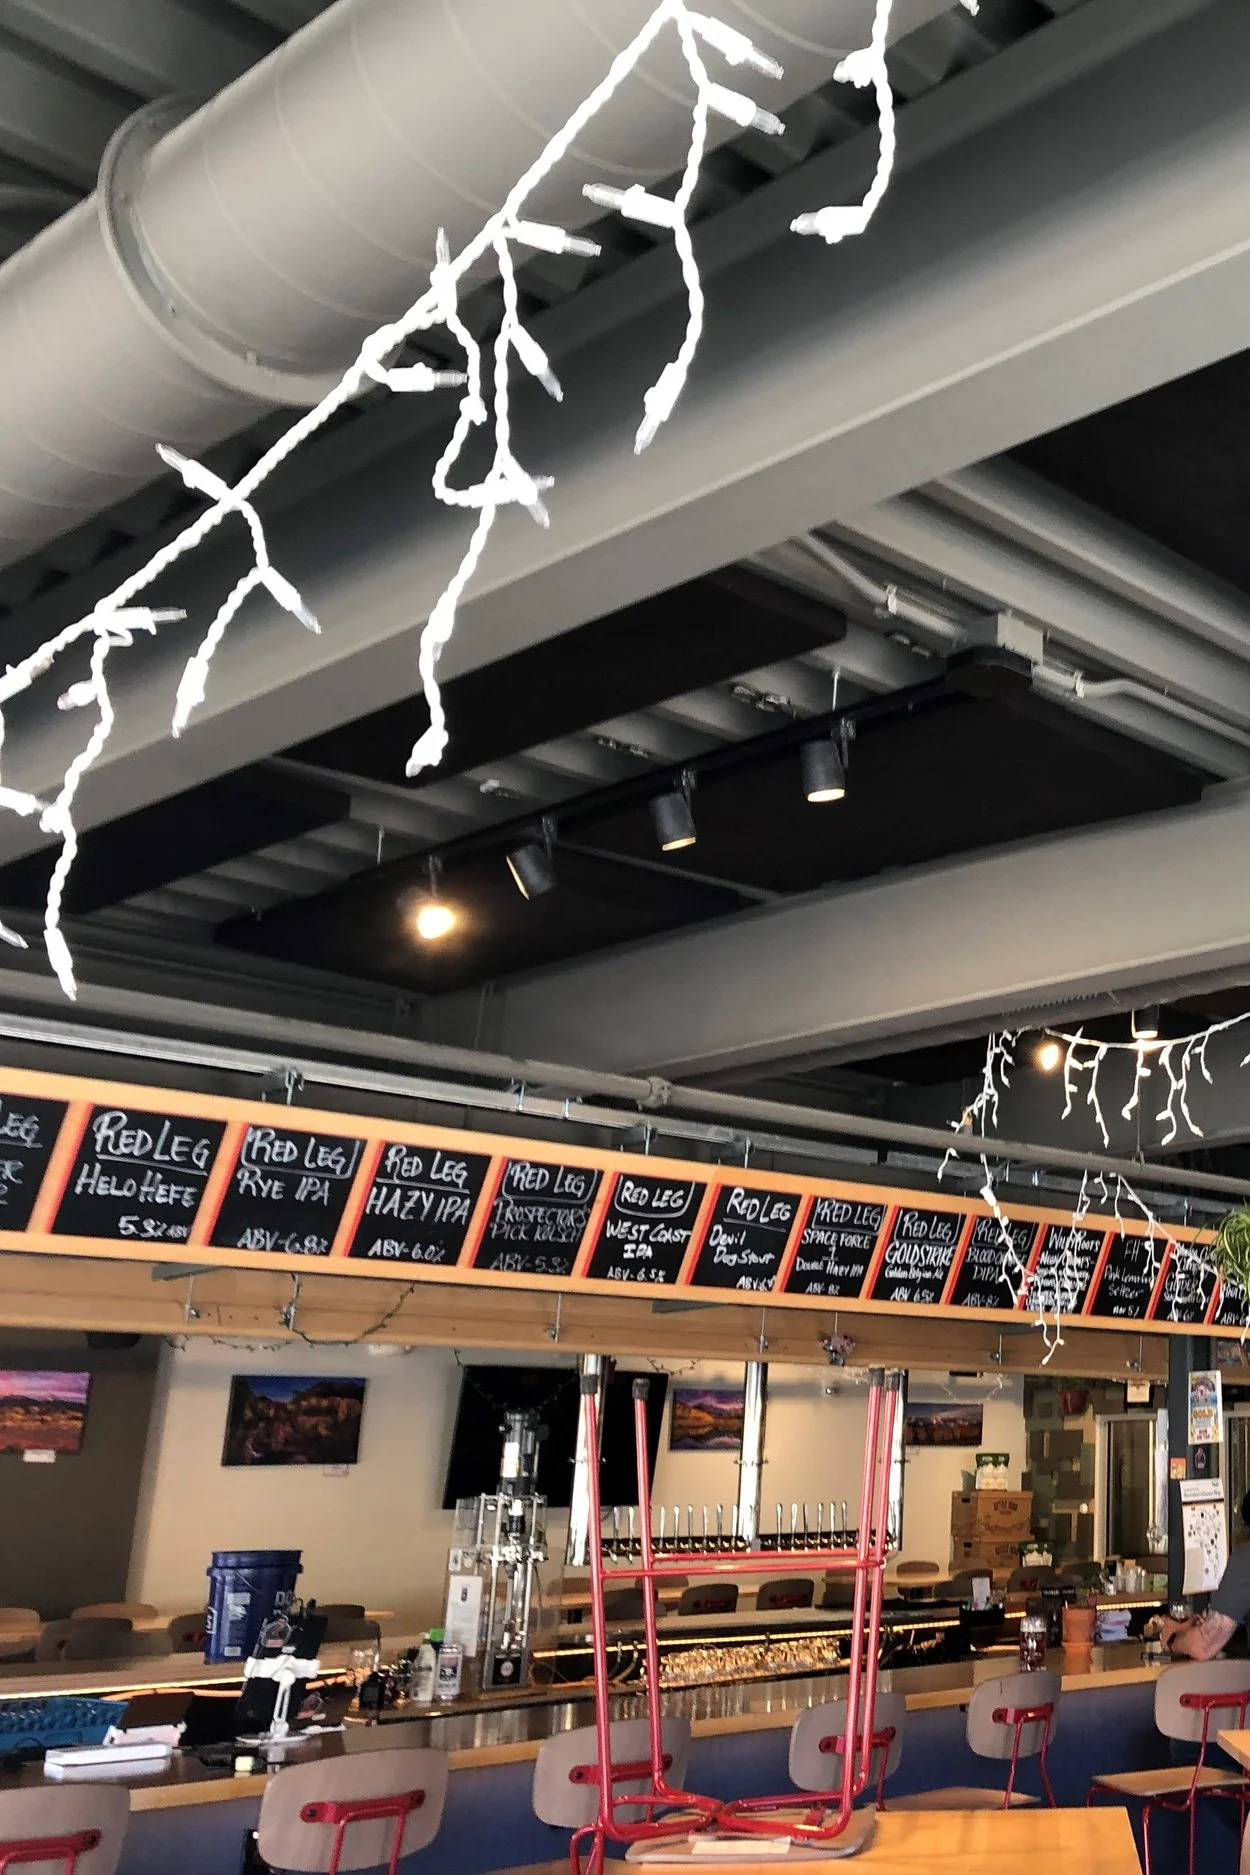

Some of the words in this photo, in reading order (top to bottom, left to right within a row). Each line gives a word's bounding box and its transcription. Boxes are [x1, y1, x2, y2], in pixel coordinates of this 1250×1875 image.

[92, 1110, 153, 1156] RED
[153, 1119, 211, 1168] LEG
[250, 1126, 297, 1163] RED
[304, 1136, 346, 1175] LEG
[75, 1162, 137, 1199] HELO
[138, 1170, 198, 1207] HEFE
[237, 1165, 285, 1200] RYE
[295, 1177, 330, 1206] IPA
[385, 1145, 423, 1183] RED
[430, 1150, 467, 1189] LEG
[510, 1161, 550, 1191] RED
[553, 1165, 585, 1198] LEG
[365, 1186, 434, 1221] HAZY
[434, 1196, 471, 1226] IPA
[621, 1179, 649, 1206] RED
[651, 1188, 685, 1209] LEG
[726, 1187, 760, 1221] RED
[760, 1195, 792, 1224] LEG
[606, 1219, 649, 1243] WEST
[649, 1223, 693, 1243] COAST
[819, 1198, 852, 1224] RED
[853, 1204, 882, 1233] LEG
[902, 1211, 928, 1238] RED
[928, 1216, 952, 1244] LEG
[623, 1243, 653, 1260] IPA
[801, 1228, 837, 1247] SPACE
[839, 1233, 871, 1250] FORCE
